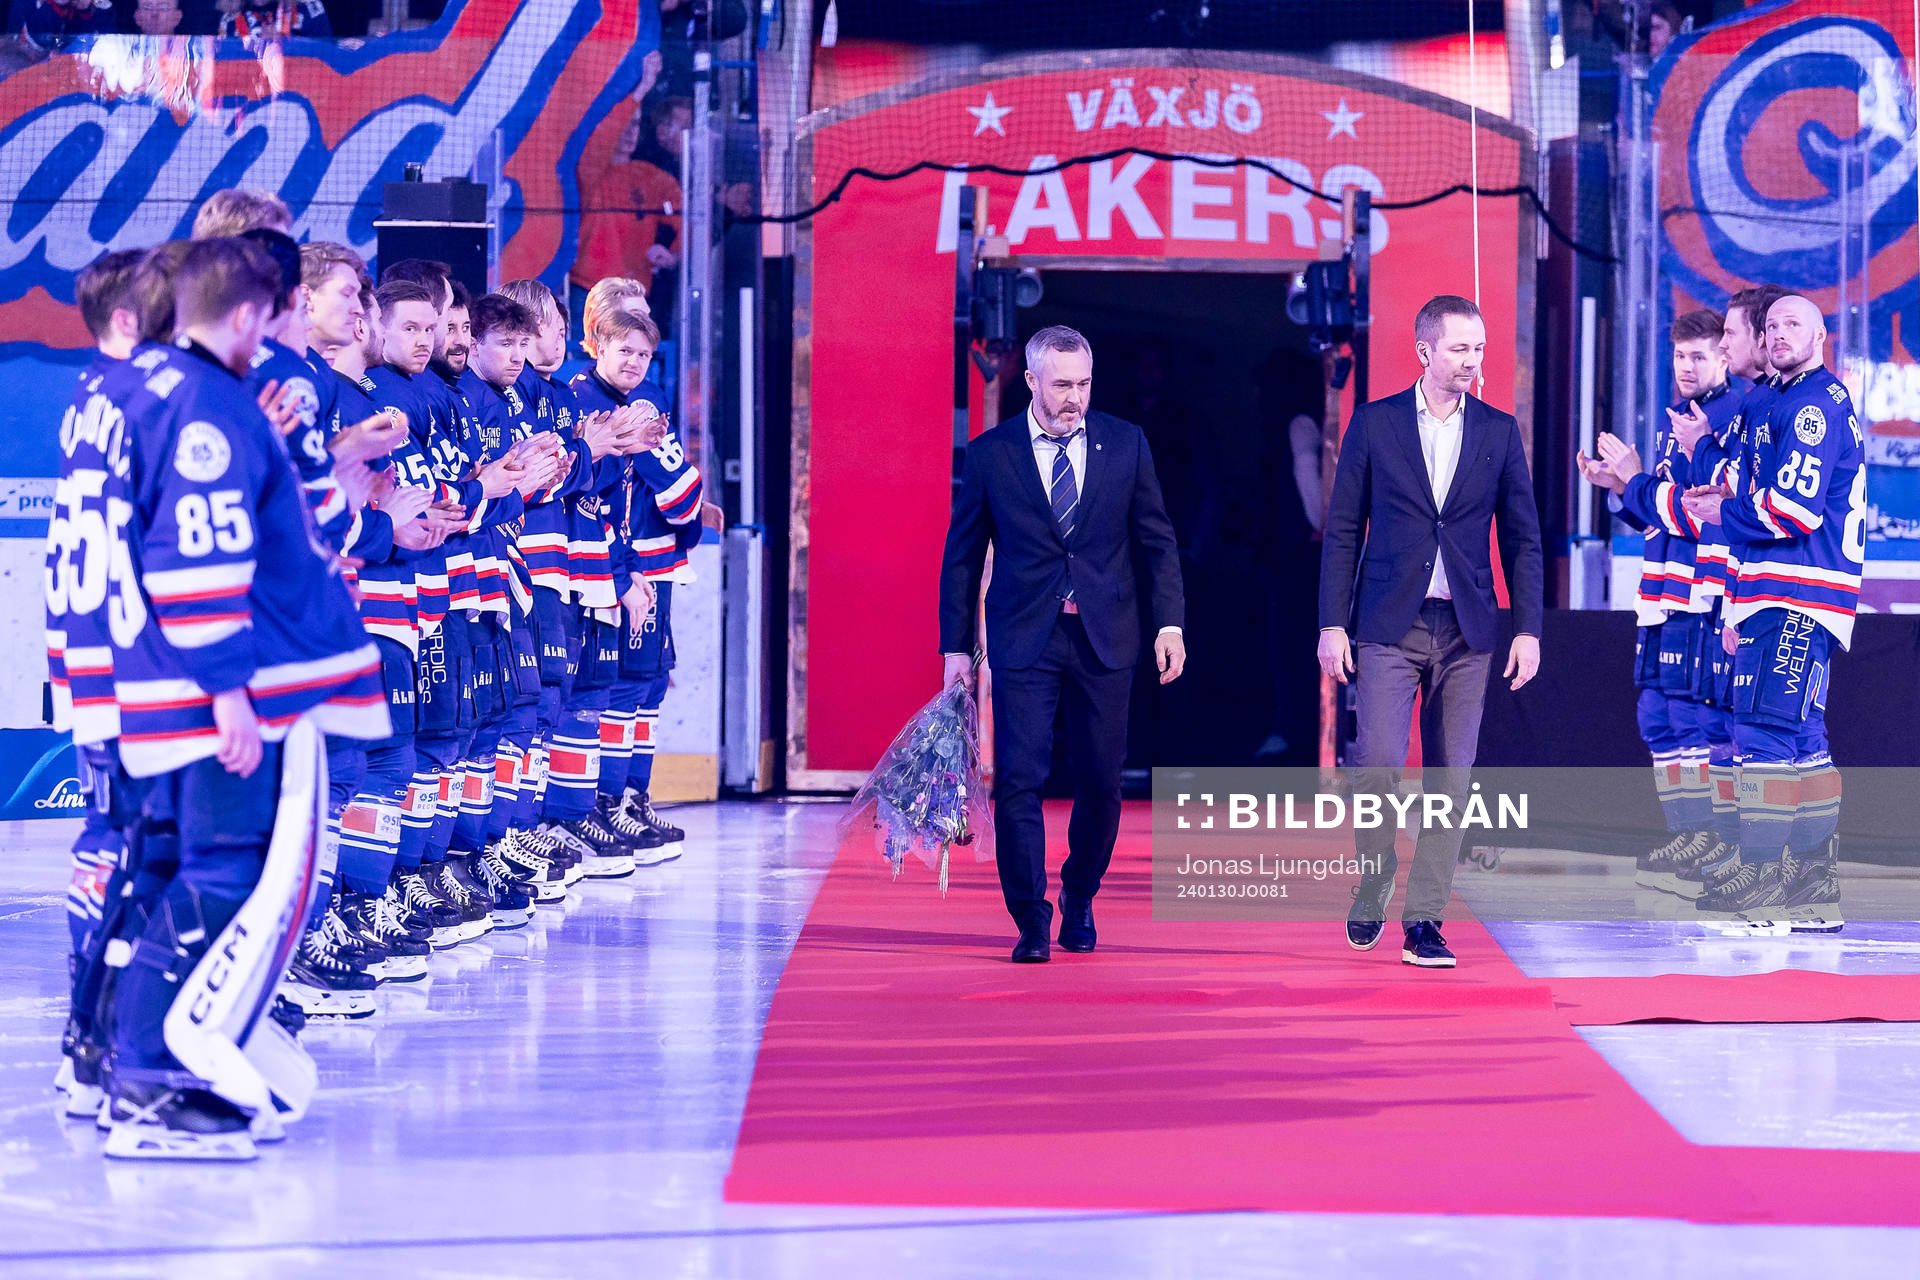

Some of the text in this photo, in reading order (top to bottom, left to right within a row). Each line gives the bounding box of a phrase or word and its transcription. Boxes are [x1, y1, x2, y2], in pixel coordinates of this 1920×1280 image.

[1066, 77, 1263, 134] VÄXJÖ
[935, 152, 1390, 257] LAKERS
[1802, 417, 1819, 435] 85
[1777, 449, 1823, 499] 85
[174, 489, 254, 558] 85
[1773, 608, 1802, 675] NORDIC
[188, 924, 249, 1025] CCM
